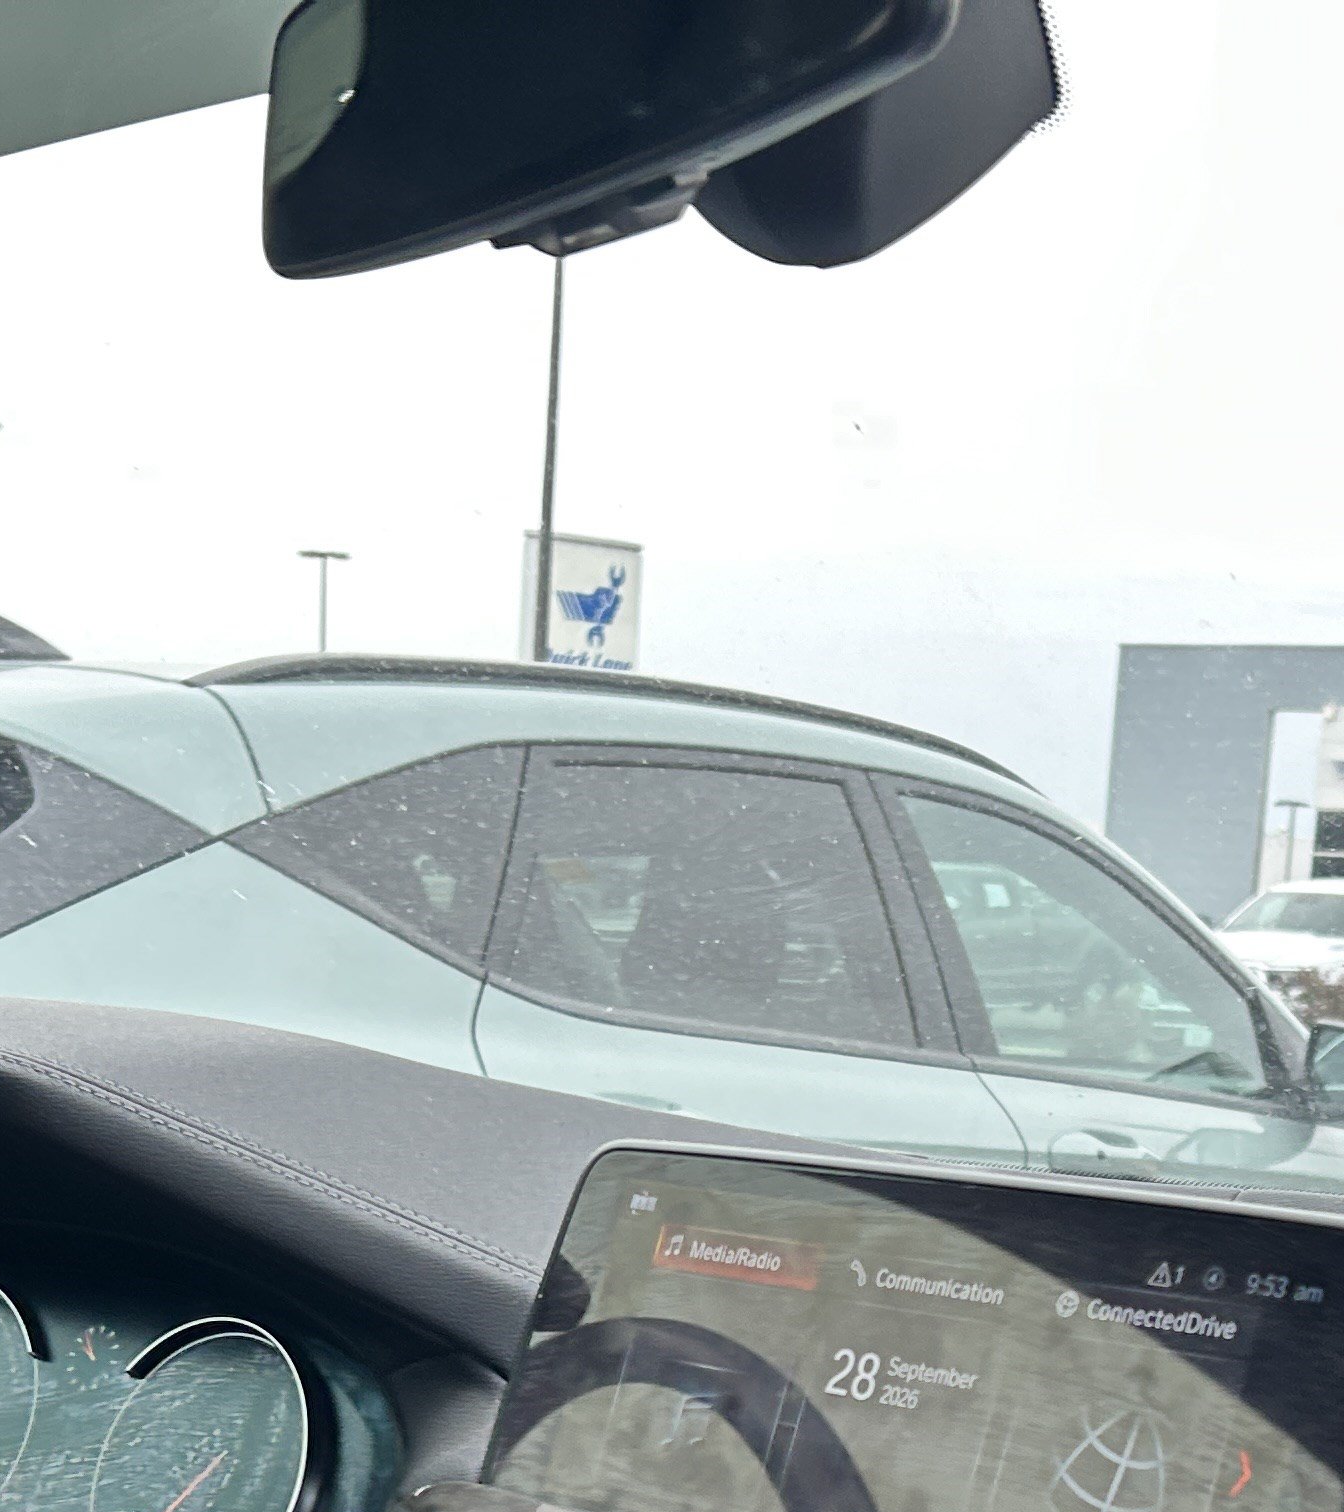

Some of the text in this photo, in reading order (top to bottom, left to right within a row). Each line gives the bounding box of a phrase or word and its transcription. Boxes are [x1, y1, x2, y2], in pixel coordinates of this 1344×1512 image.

[689, 1240, 782, 1273] Media/Radio
[875, 1267, 1005, 1306] Communication
[1293, 1284, 1325, 1303] am
[1086, 1298, 1238, 1341] ConnectedDrive
[824, 1347, 882, 1401] 28
[887, 1355, 979, 1390] September
